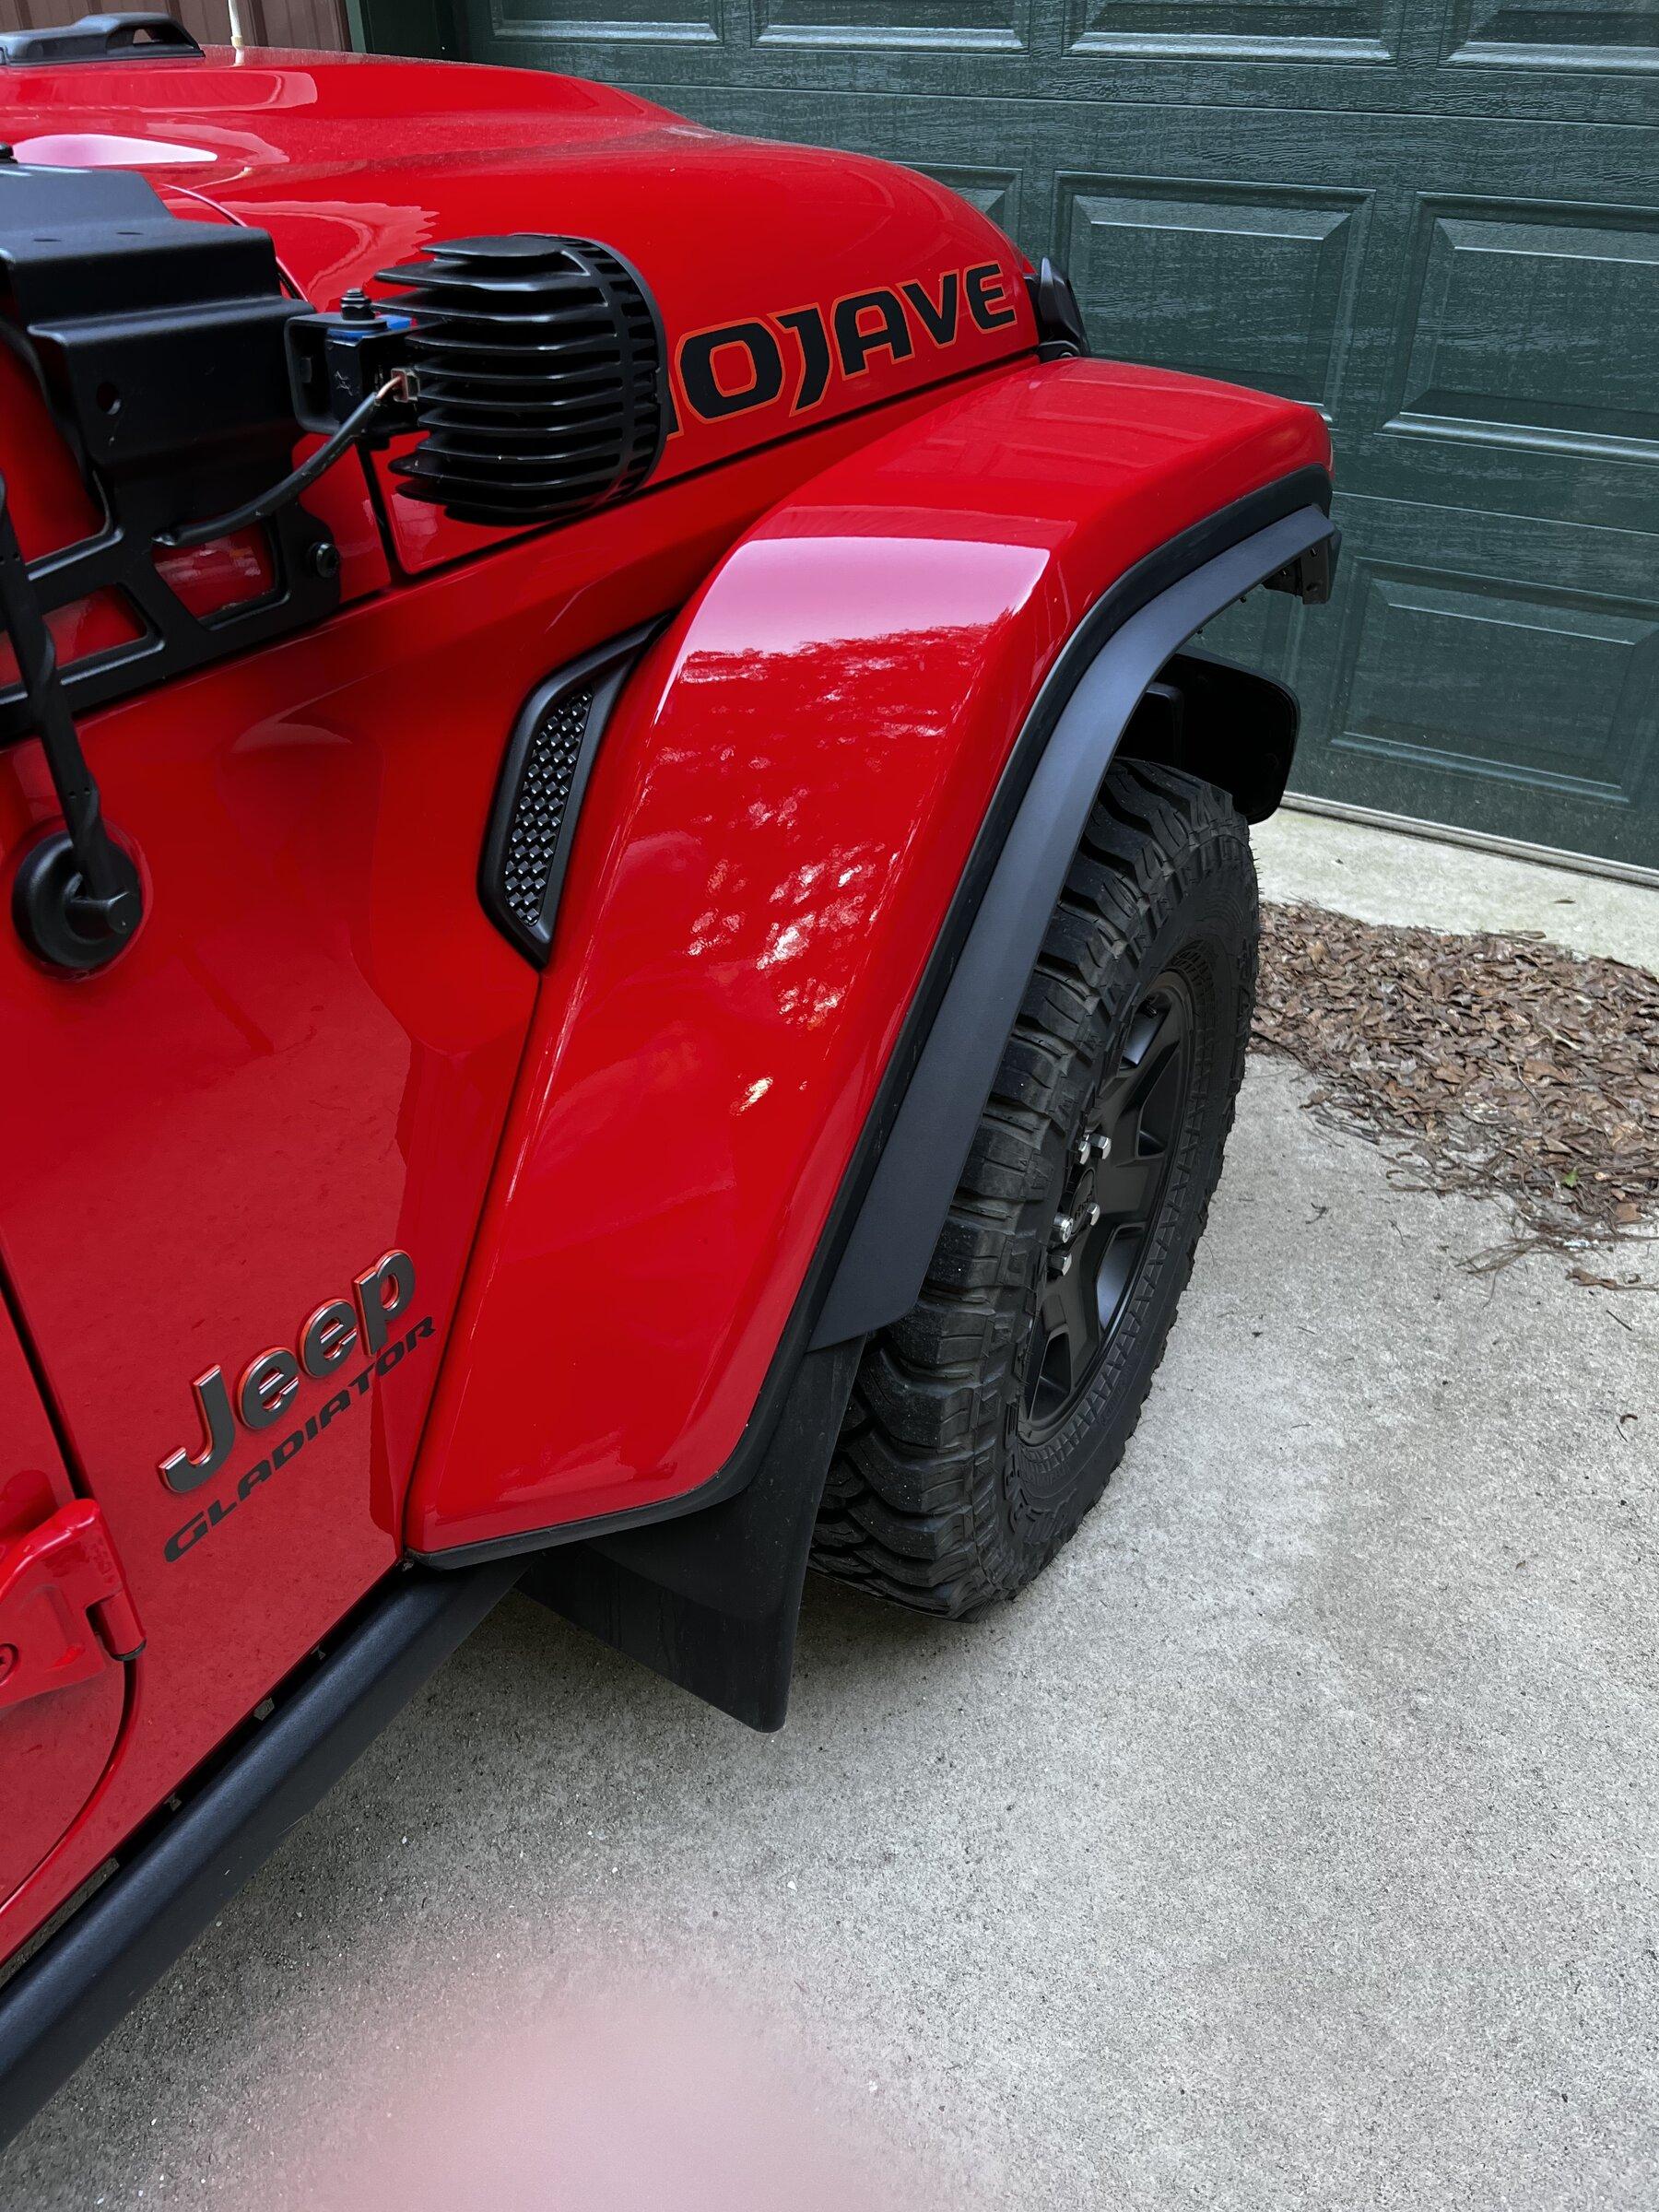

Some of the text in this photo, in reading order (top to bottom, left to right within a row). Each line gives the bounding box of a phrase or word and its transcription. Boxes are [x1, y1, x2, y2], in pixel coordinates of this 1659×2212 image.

[666, 261, 1018, 441] OJAVE
[157, 1248, 417, 1494] Jeep
[163, 1315, 436, 1563] GLADIATOR
